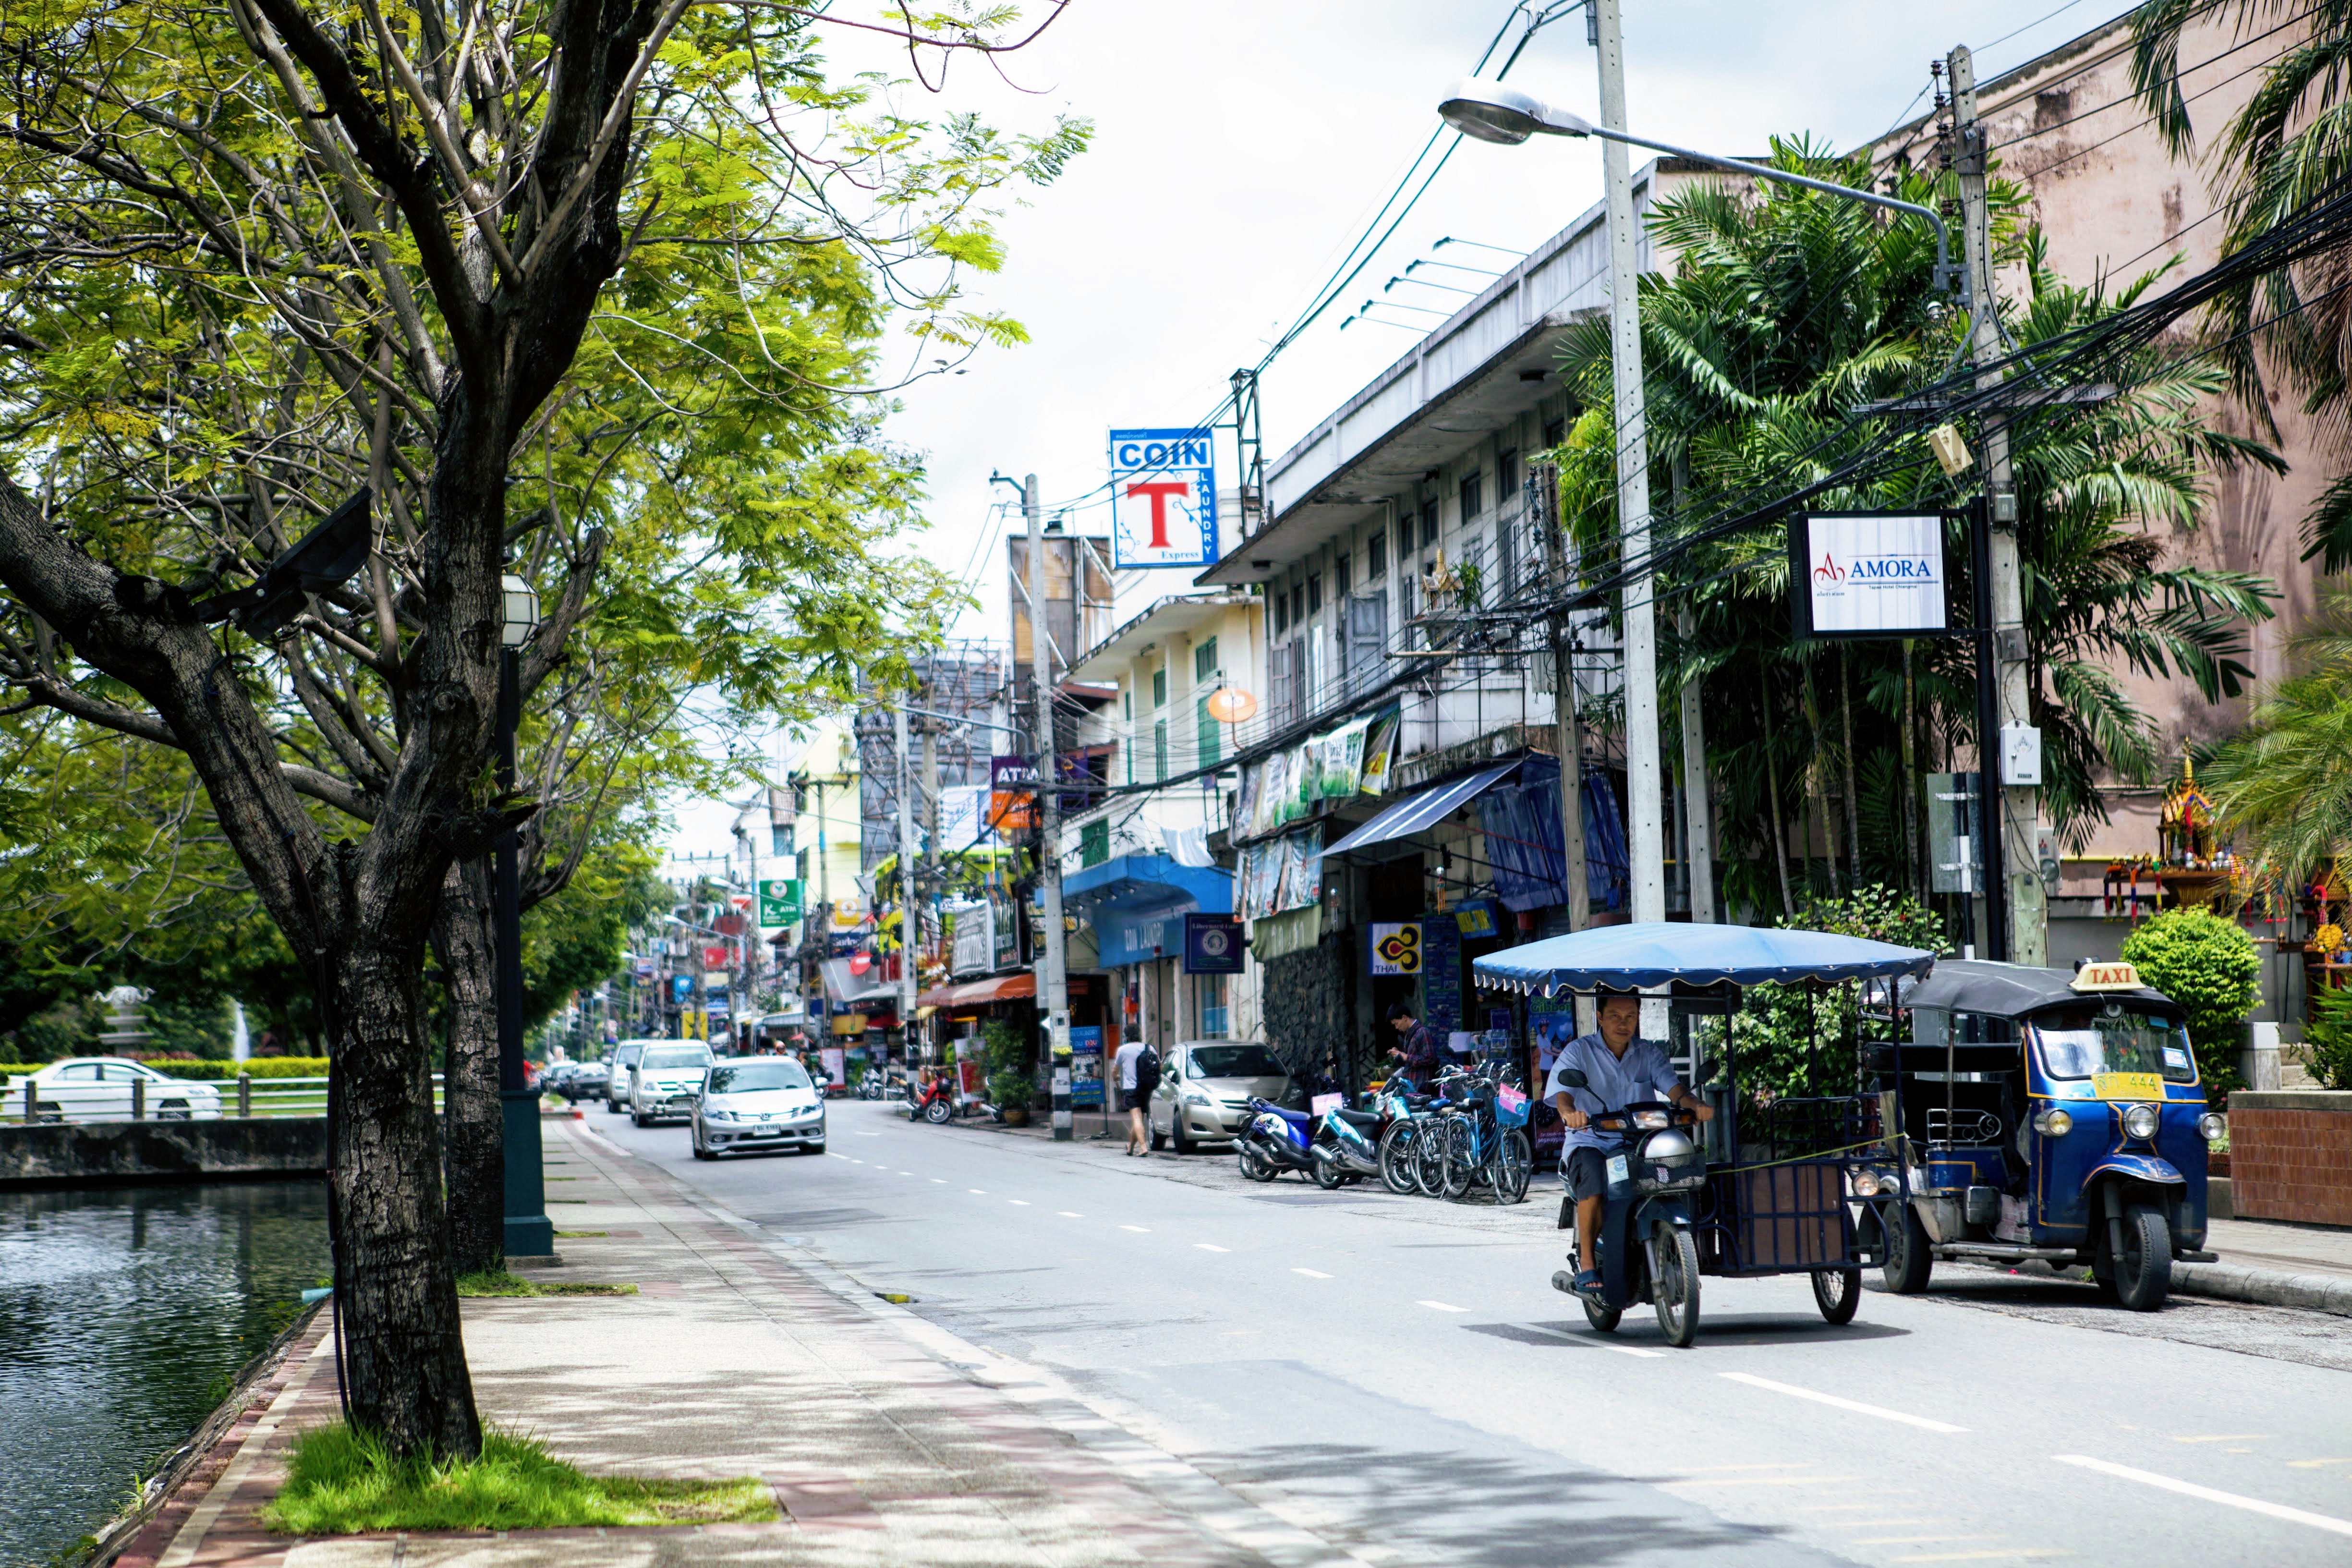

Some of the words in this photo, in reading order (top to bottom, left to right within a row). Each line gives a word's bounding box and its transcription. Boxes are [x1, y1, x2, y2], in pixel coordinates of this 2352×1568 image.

[1119, 442, 1207, 467] COIN
[1127, 482, 1189, 548] T
[1201, 472, 1212, 554] LAUNDRY
[1161, 550, 1200, 561] Express
[1850, 559, 1931, 578] AMORA
[2090, 968, 2131, 984] TAXI
[1072, 1057, 1095, 1065] Wash
[1077, 1075, 1092, 1083] Dry
[2130, 1075, 2157, 1087] 444
[1501, 1089, 1510, 1099] For
